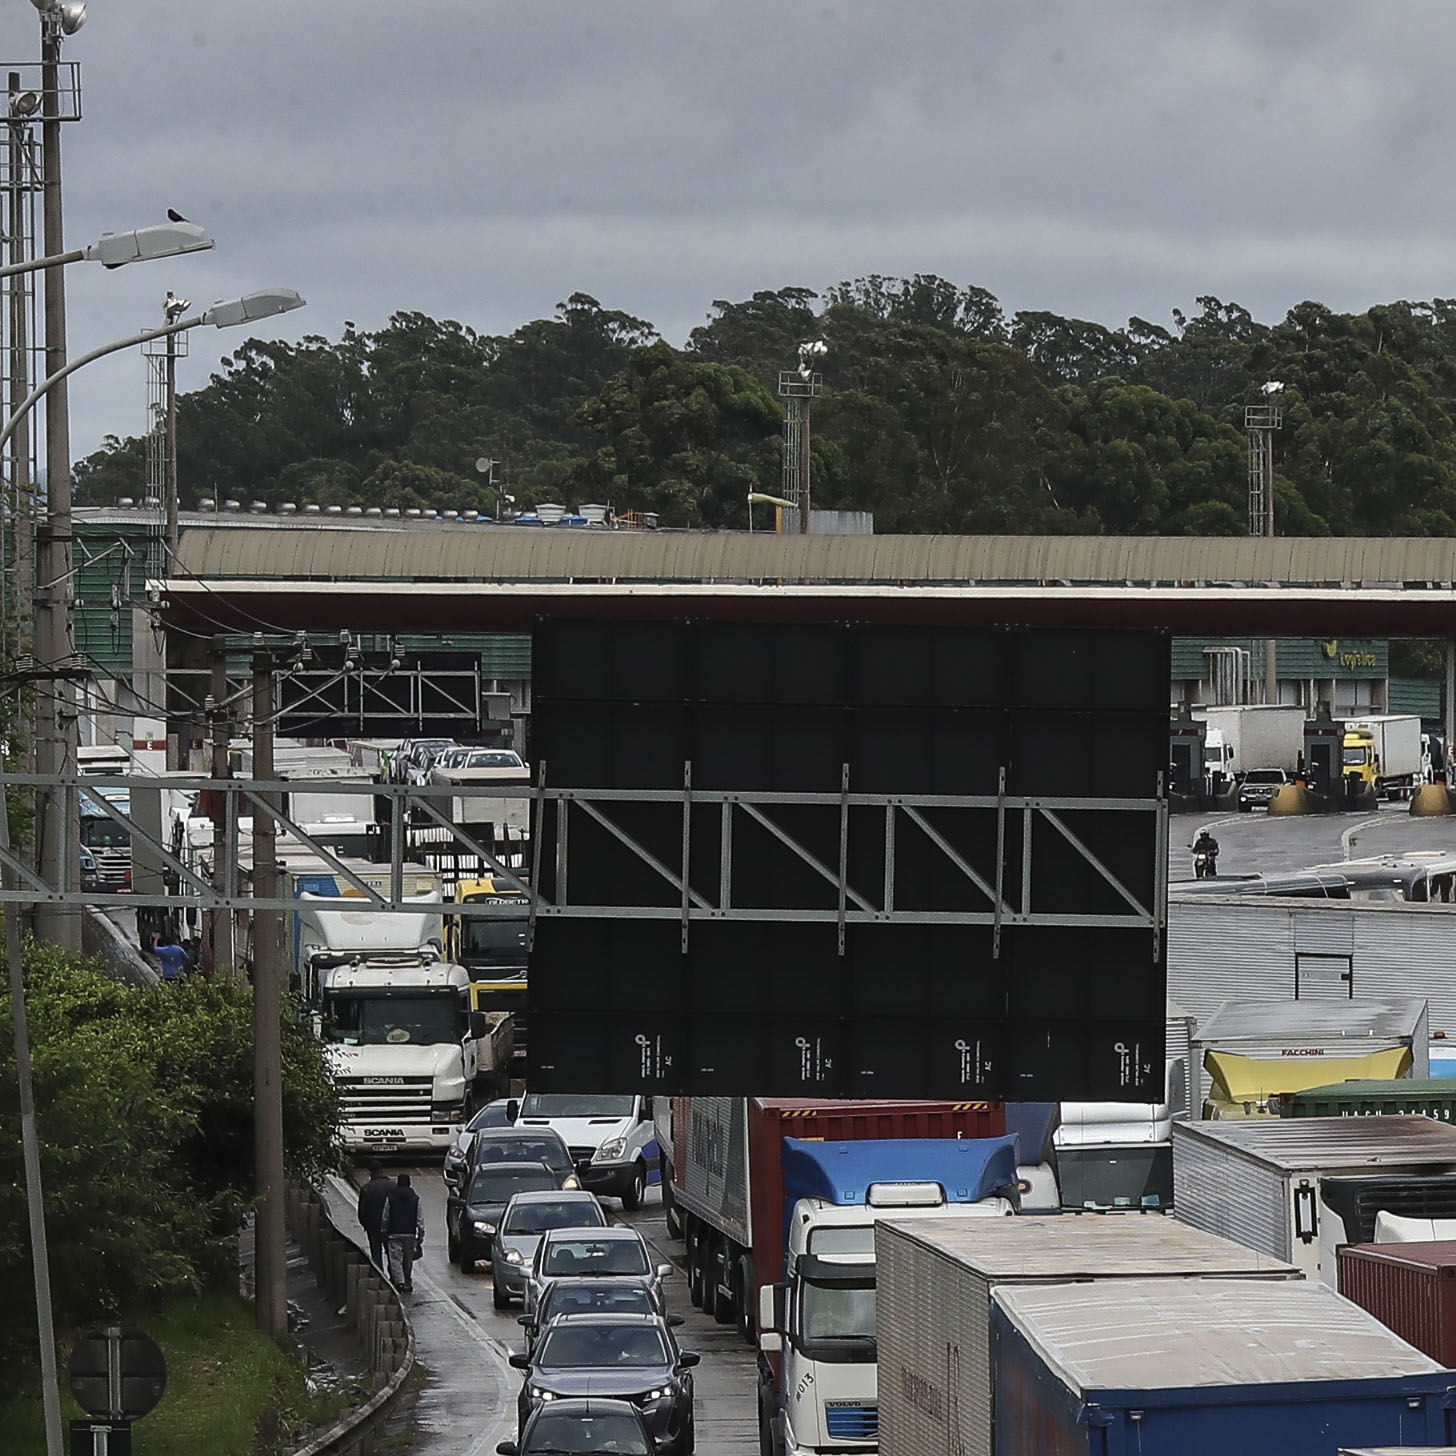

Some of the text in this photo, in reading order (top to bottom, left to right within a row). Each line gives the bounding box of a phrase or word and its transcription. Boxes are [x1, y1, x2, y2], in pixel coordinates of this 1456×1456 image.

[147, 741, 153, 750] E
[363, 1077, 405, 1085] SCANIA
[363, 1128, 405, 1137] SCANIA
